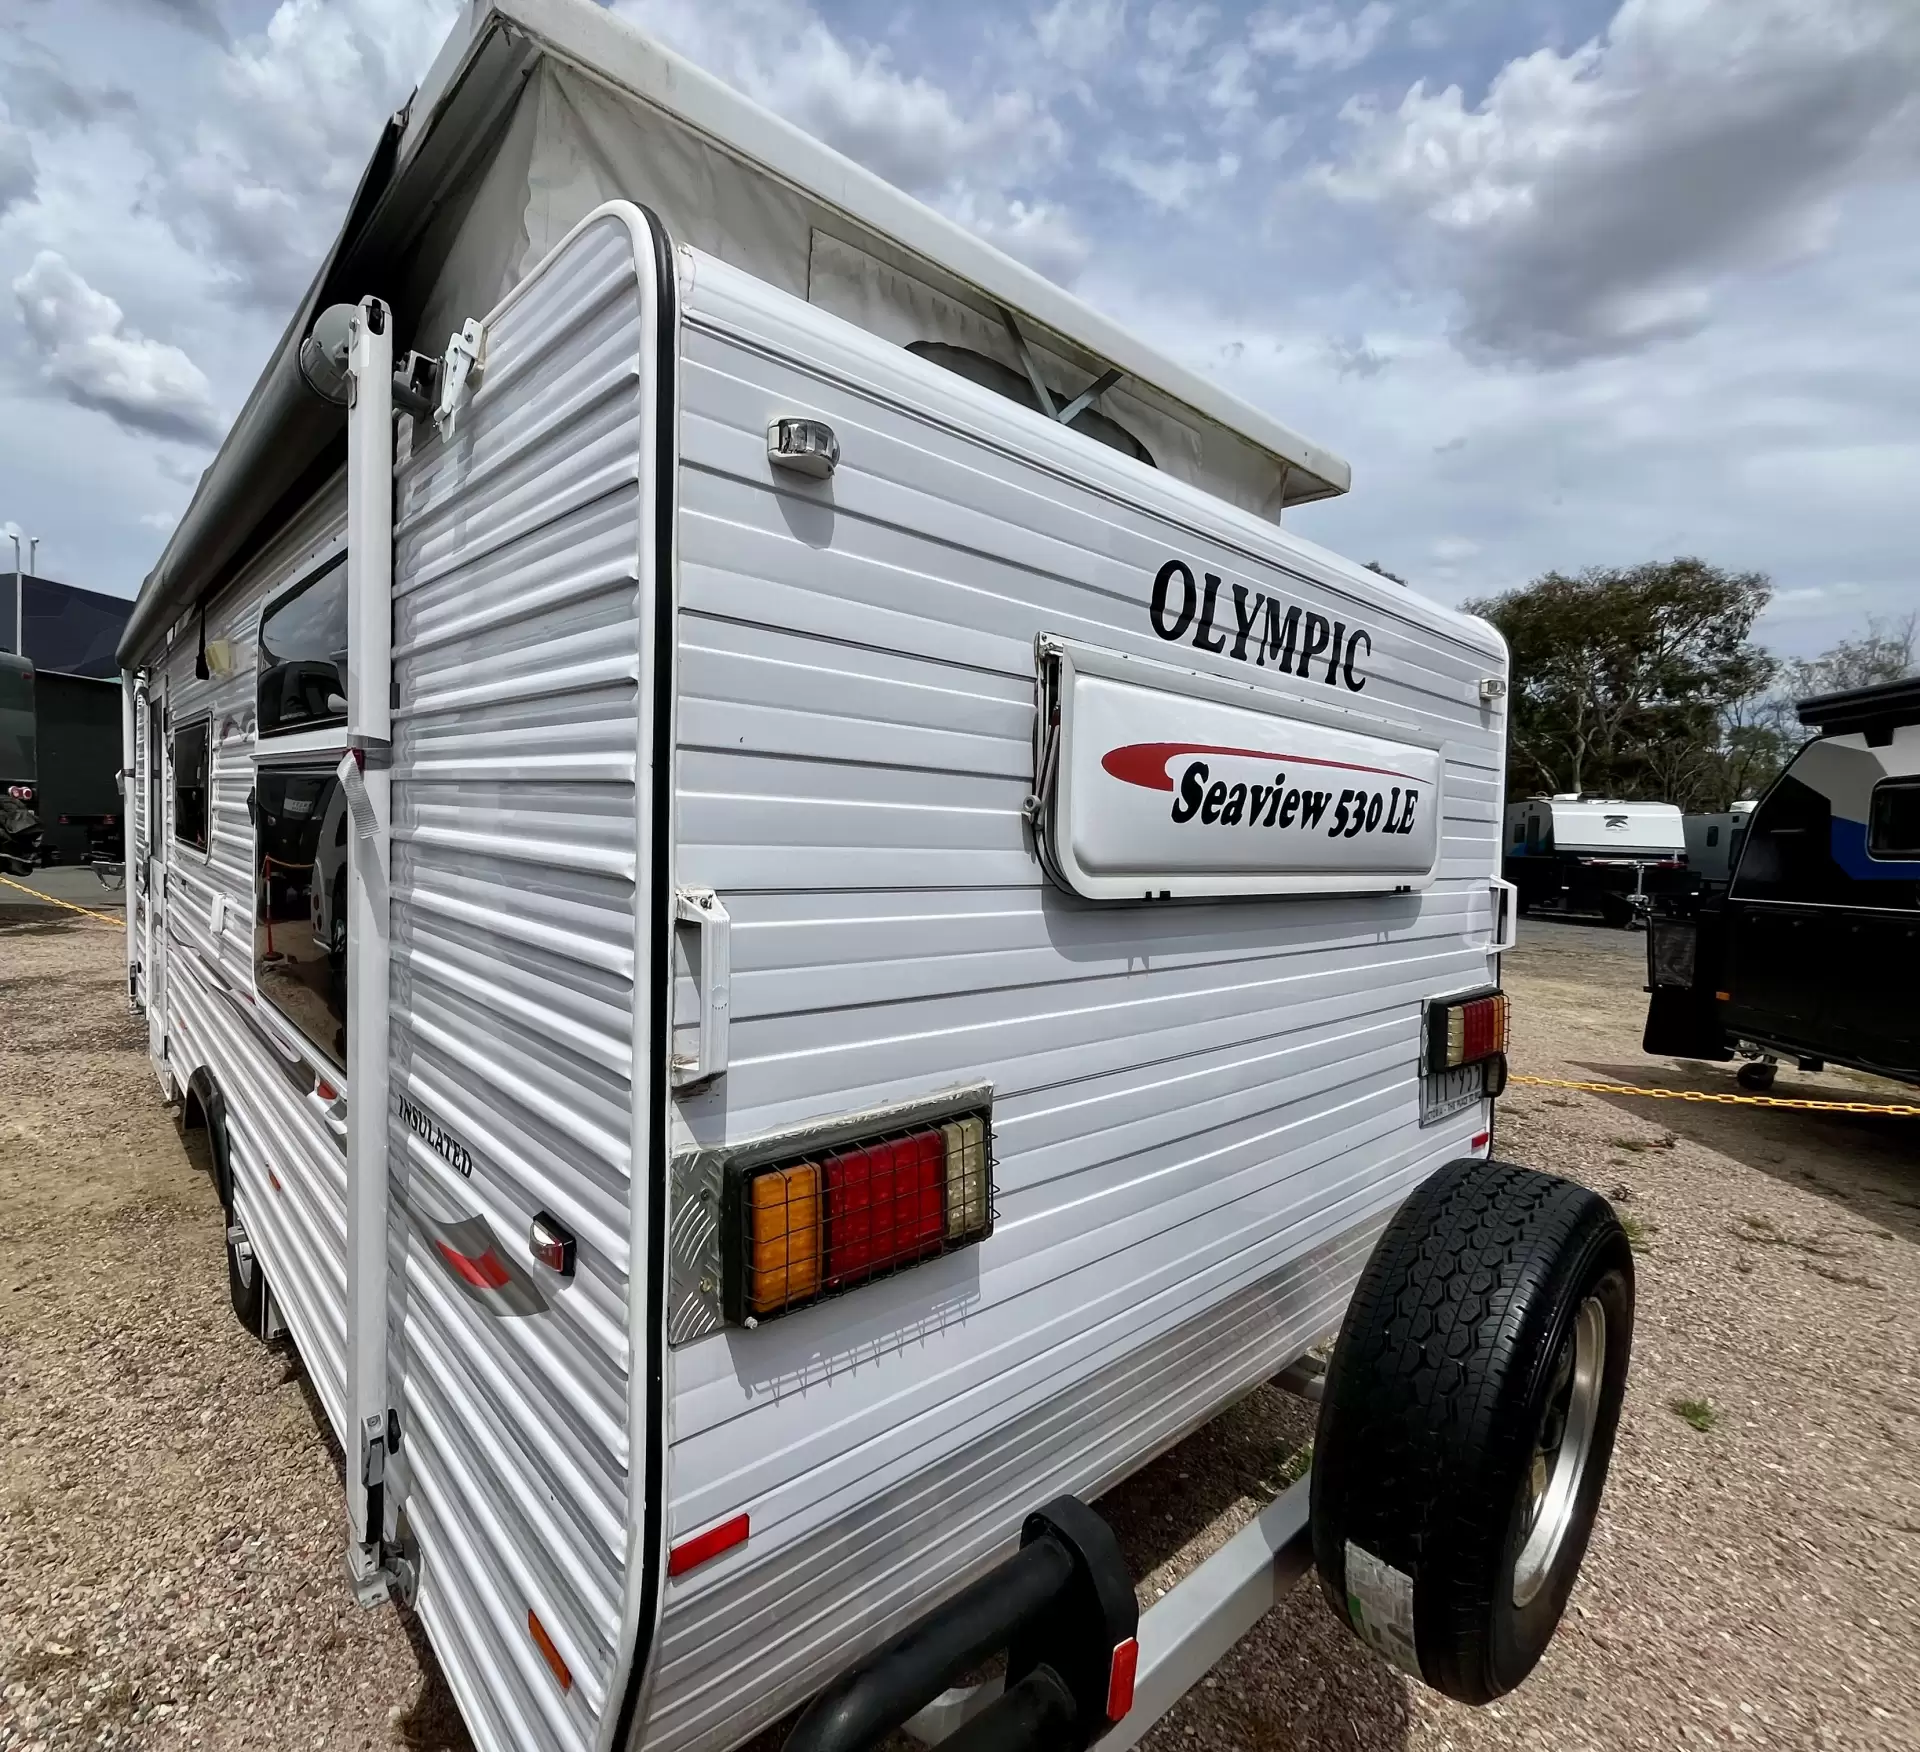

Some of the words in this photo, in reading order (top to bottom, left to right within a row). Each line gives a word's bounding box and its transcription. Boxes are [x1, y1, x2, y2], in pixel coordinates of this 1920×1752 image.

[1149, 559, 1372, 692] OLYMPIC
[1171, 761, 1333, 829] Seaview
[1327, 788, 1384, 838] 530
[1381, 786, 1419, 836] LE
[398, 1094, 473, 1179] INSULATED
